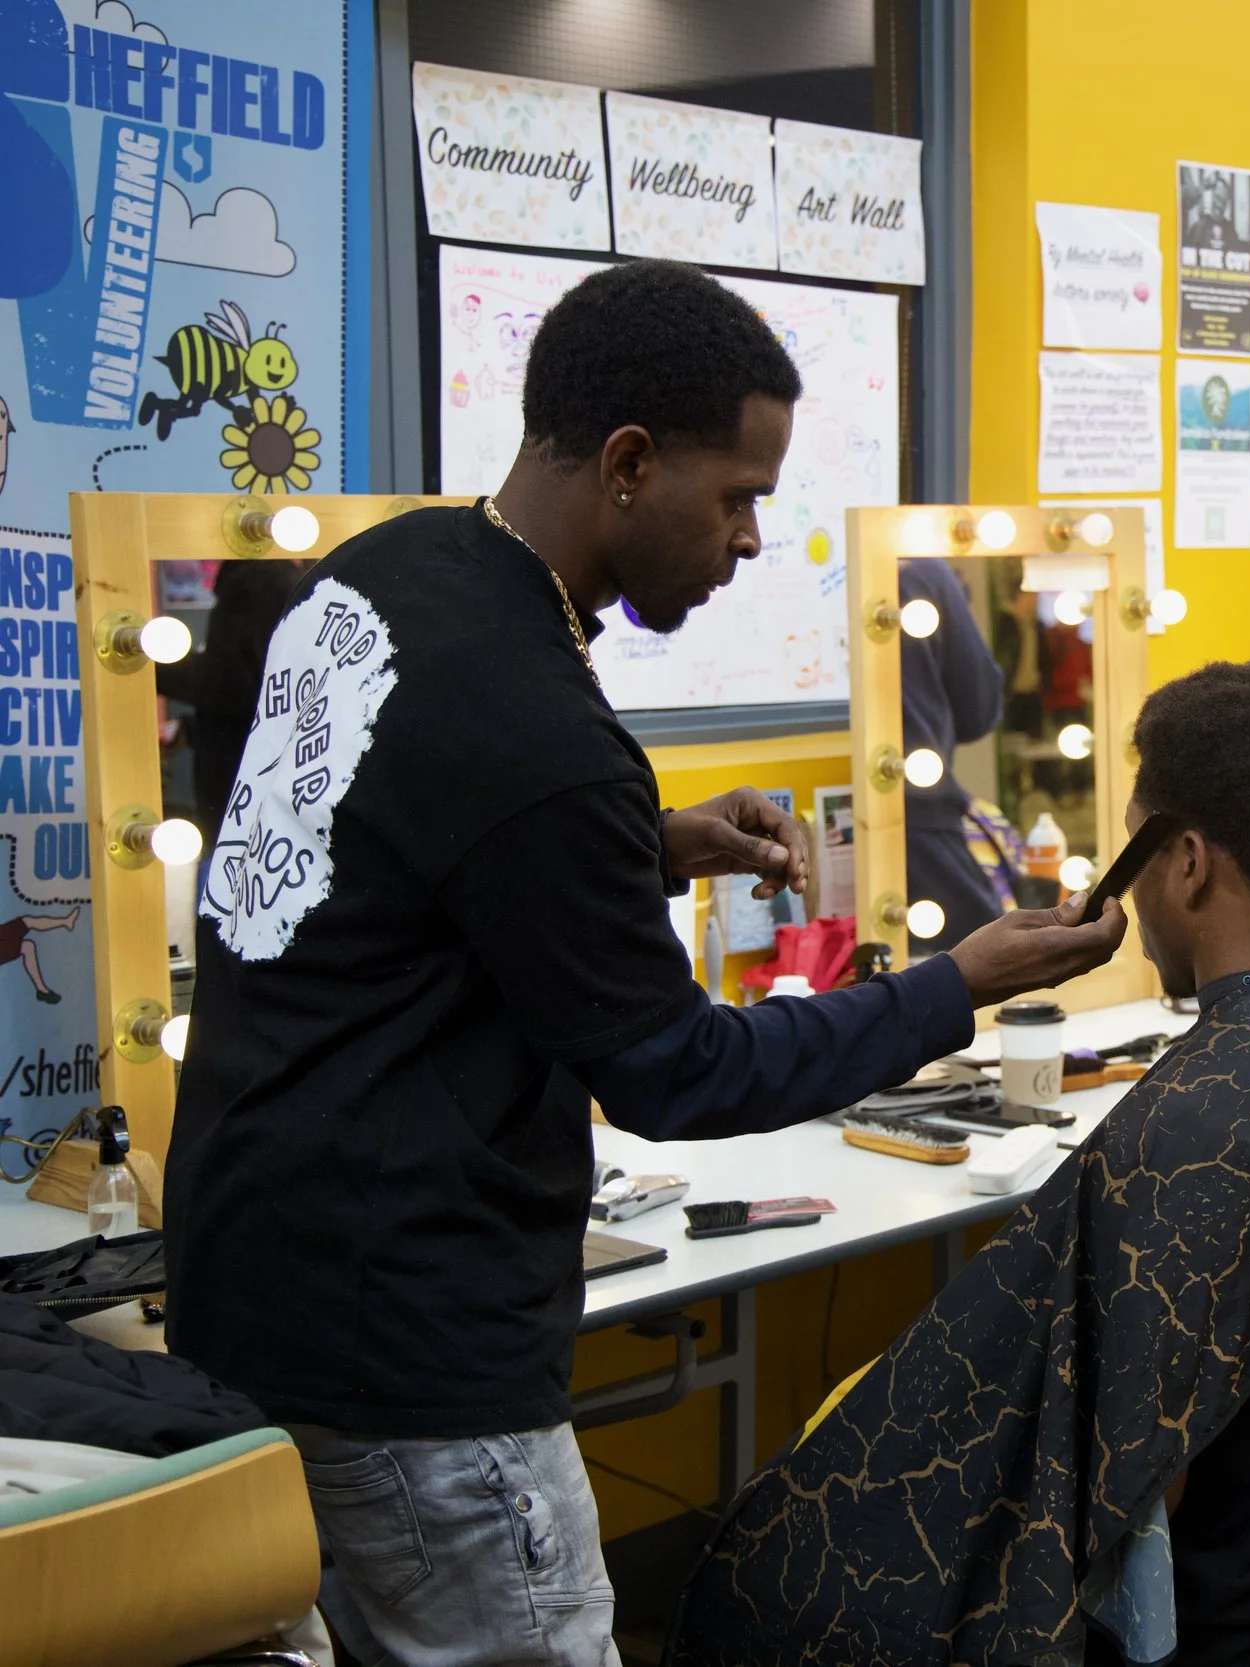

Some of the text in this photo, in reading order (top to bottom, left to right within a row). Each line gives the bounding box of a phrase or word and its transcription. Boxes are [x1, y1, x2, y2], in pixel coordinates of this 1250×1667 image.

[426, 126, 594, 202] Community
[628, 157, 758, 224] Wellbeing
[797, 186, 906, 231] Art Wall
[83, 126, 162, 422] VOLUNTEERING
[315, 601, 377, 671] TOP
